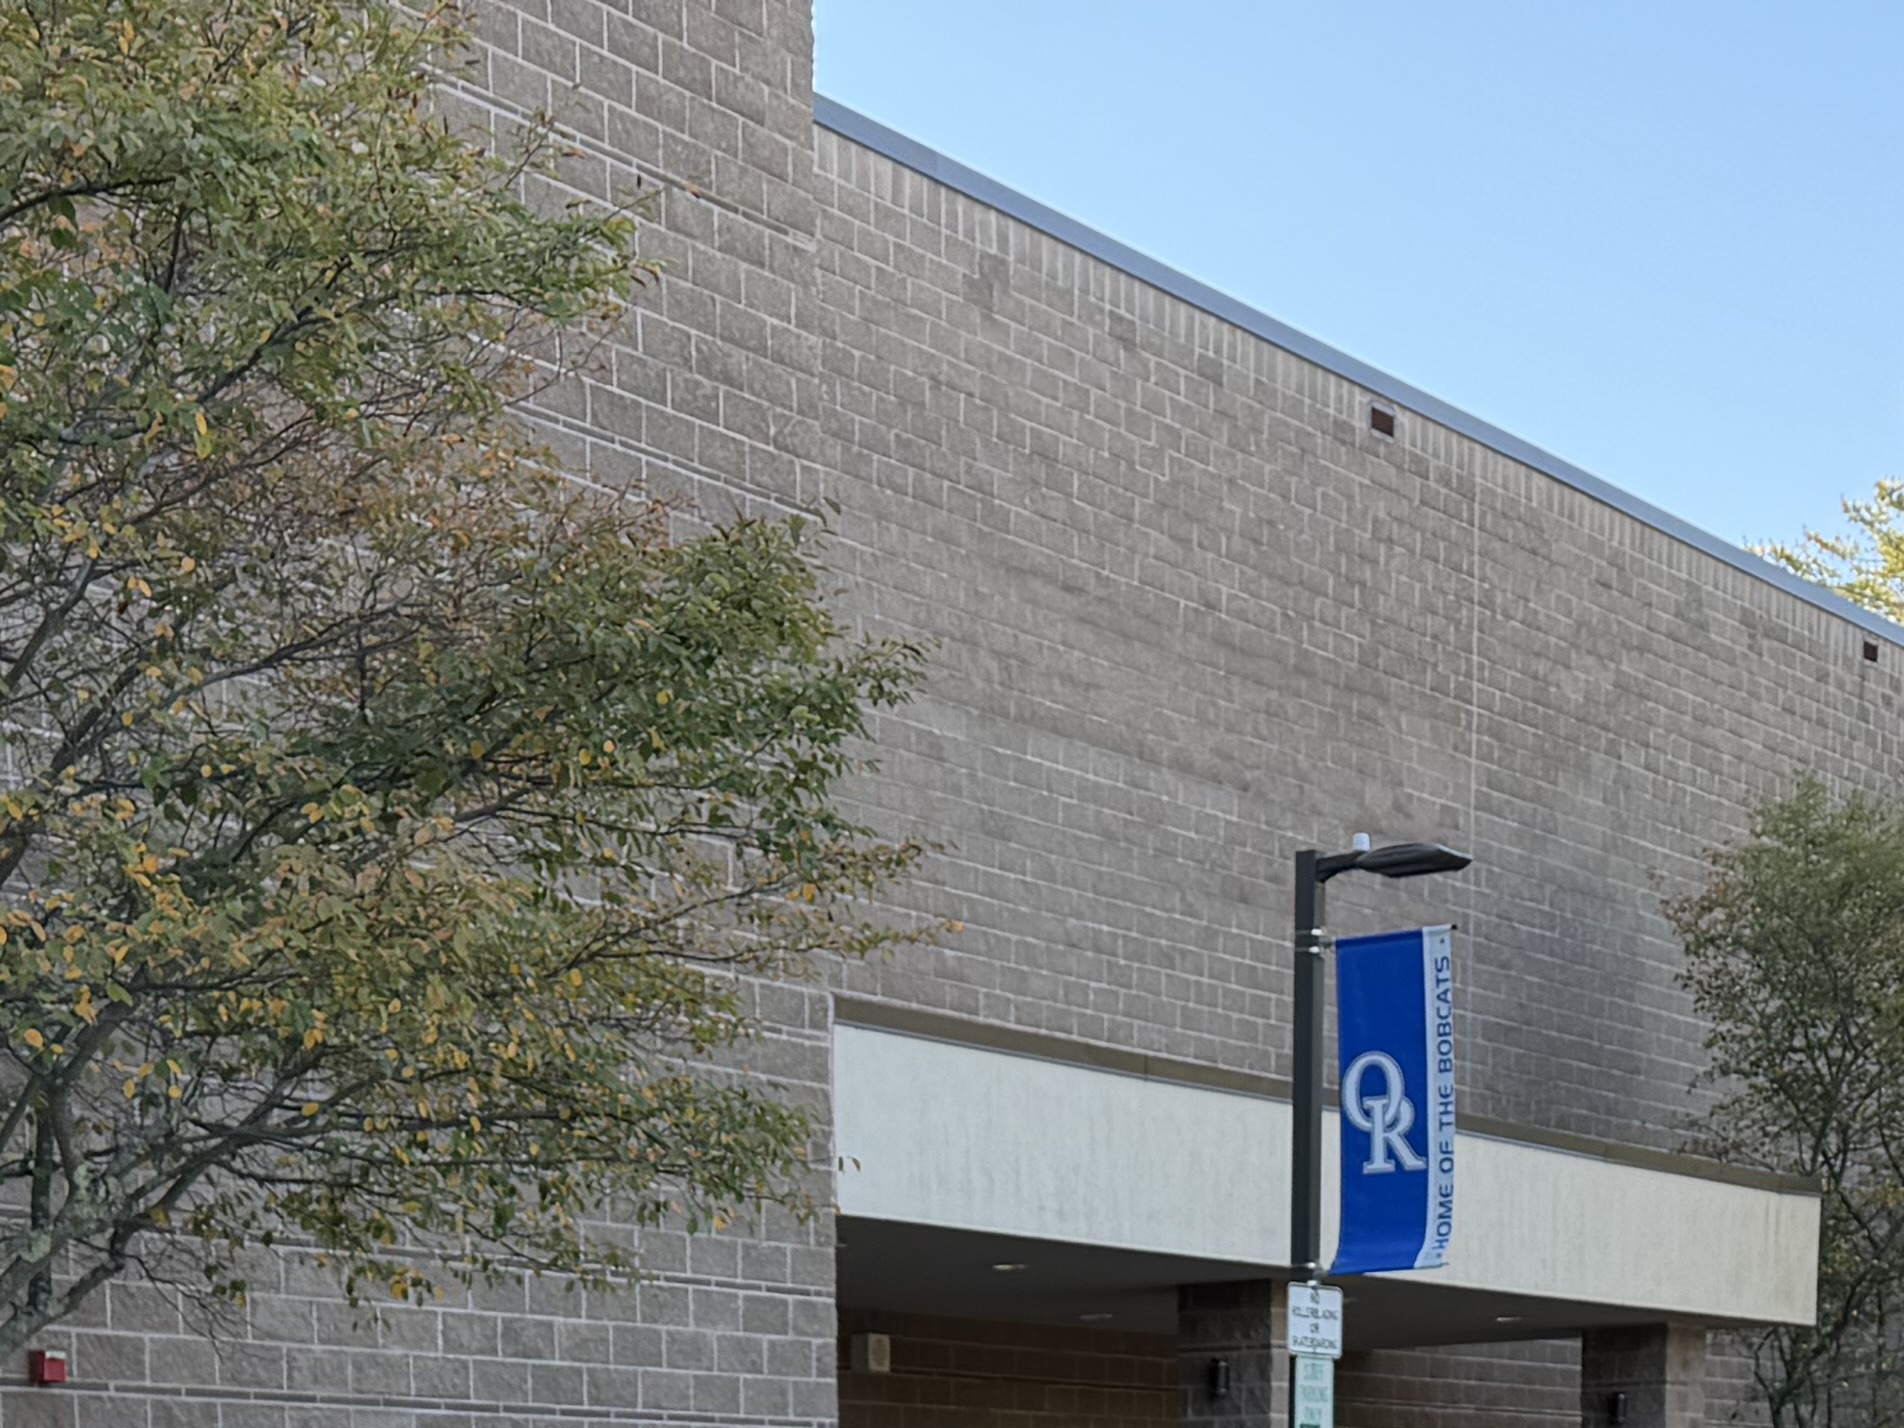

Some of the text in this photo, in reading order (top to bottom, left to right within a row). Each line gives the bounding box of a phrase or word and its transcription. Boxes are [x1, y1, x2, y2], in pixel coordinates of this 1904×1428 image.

[1432, 955, 1455, 1250] HOME OF THE BOBCATS
